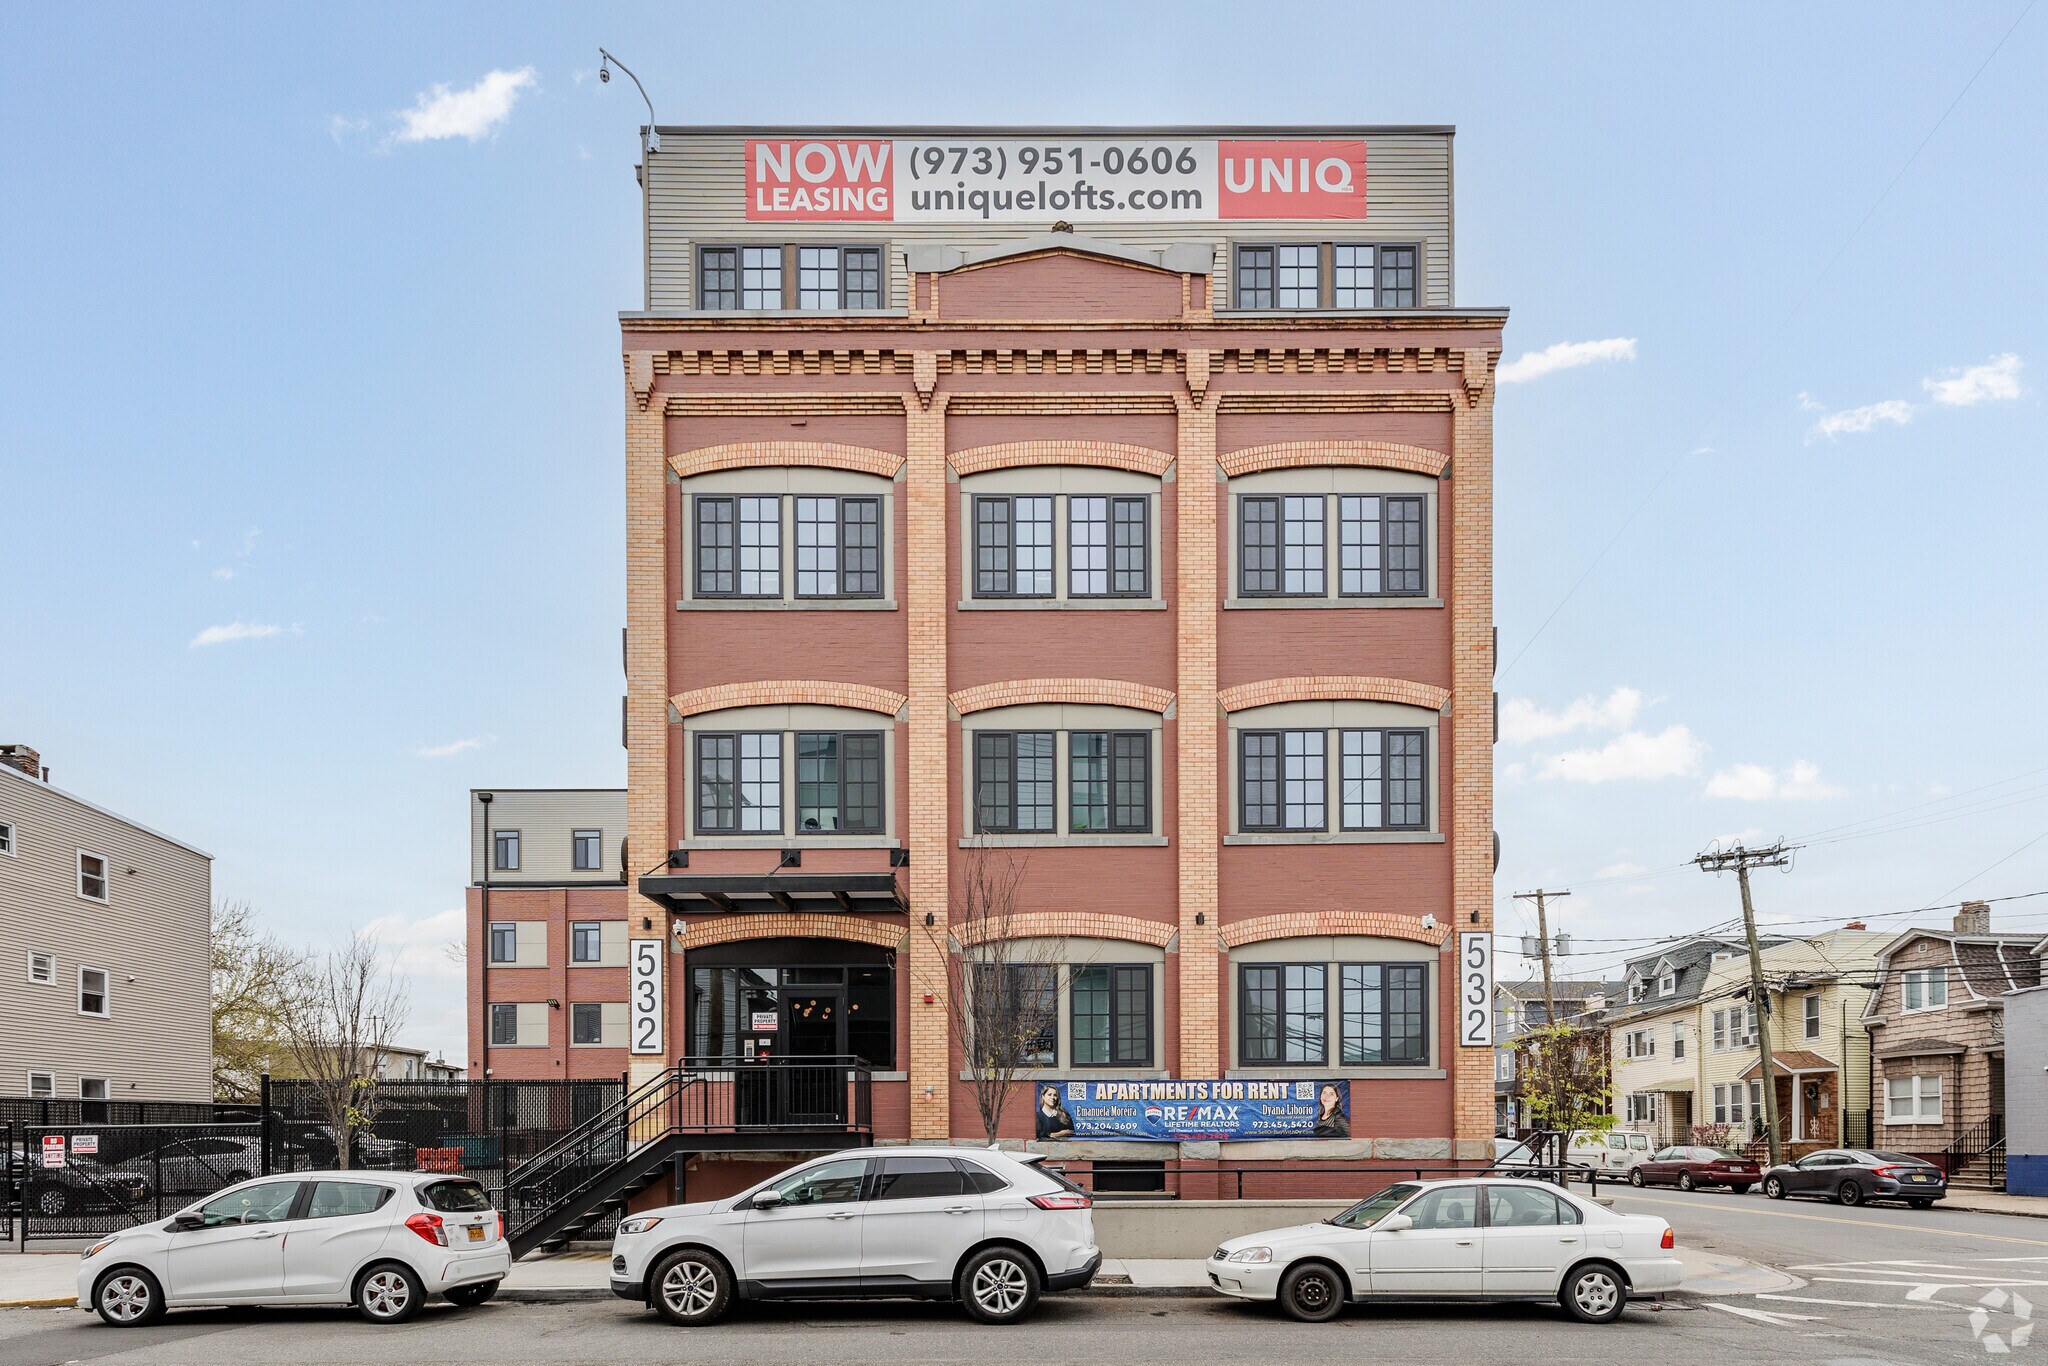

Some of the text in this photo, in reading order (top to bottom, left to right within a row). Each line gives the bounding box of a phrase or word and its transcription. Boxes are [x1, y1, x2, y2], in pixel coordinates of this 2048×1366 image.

[755, 142, 890, 184] NOW
[910, 146, 1197, 180] (973) 951-0606
[1224, 157, 1354, 194] UNIQ
[757, 186, 888, 212] LEASING
[911, 180, 1202, 219] uniquelofts.com
[637, 944, 656, 1049] 532
[1467, 937, 1486, 1041] 532
[1095, 1082, 1290, 1101] APARTMENTS FOR RENT
[1076, 1105, 1137, 1117] Emanuela Moreira
[1164, 1106, 1240, 1120] RE/MAX
[1262, 1104, 1314, 1116] Dyana Liborio
[1076, 1122, 1138, 1130] 973.204.3609
